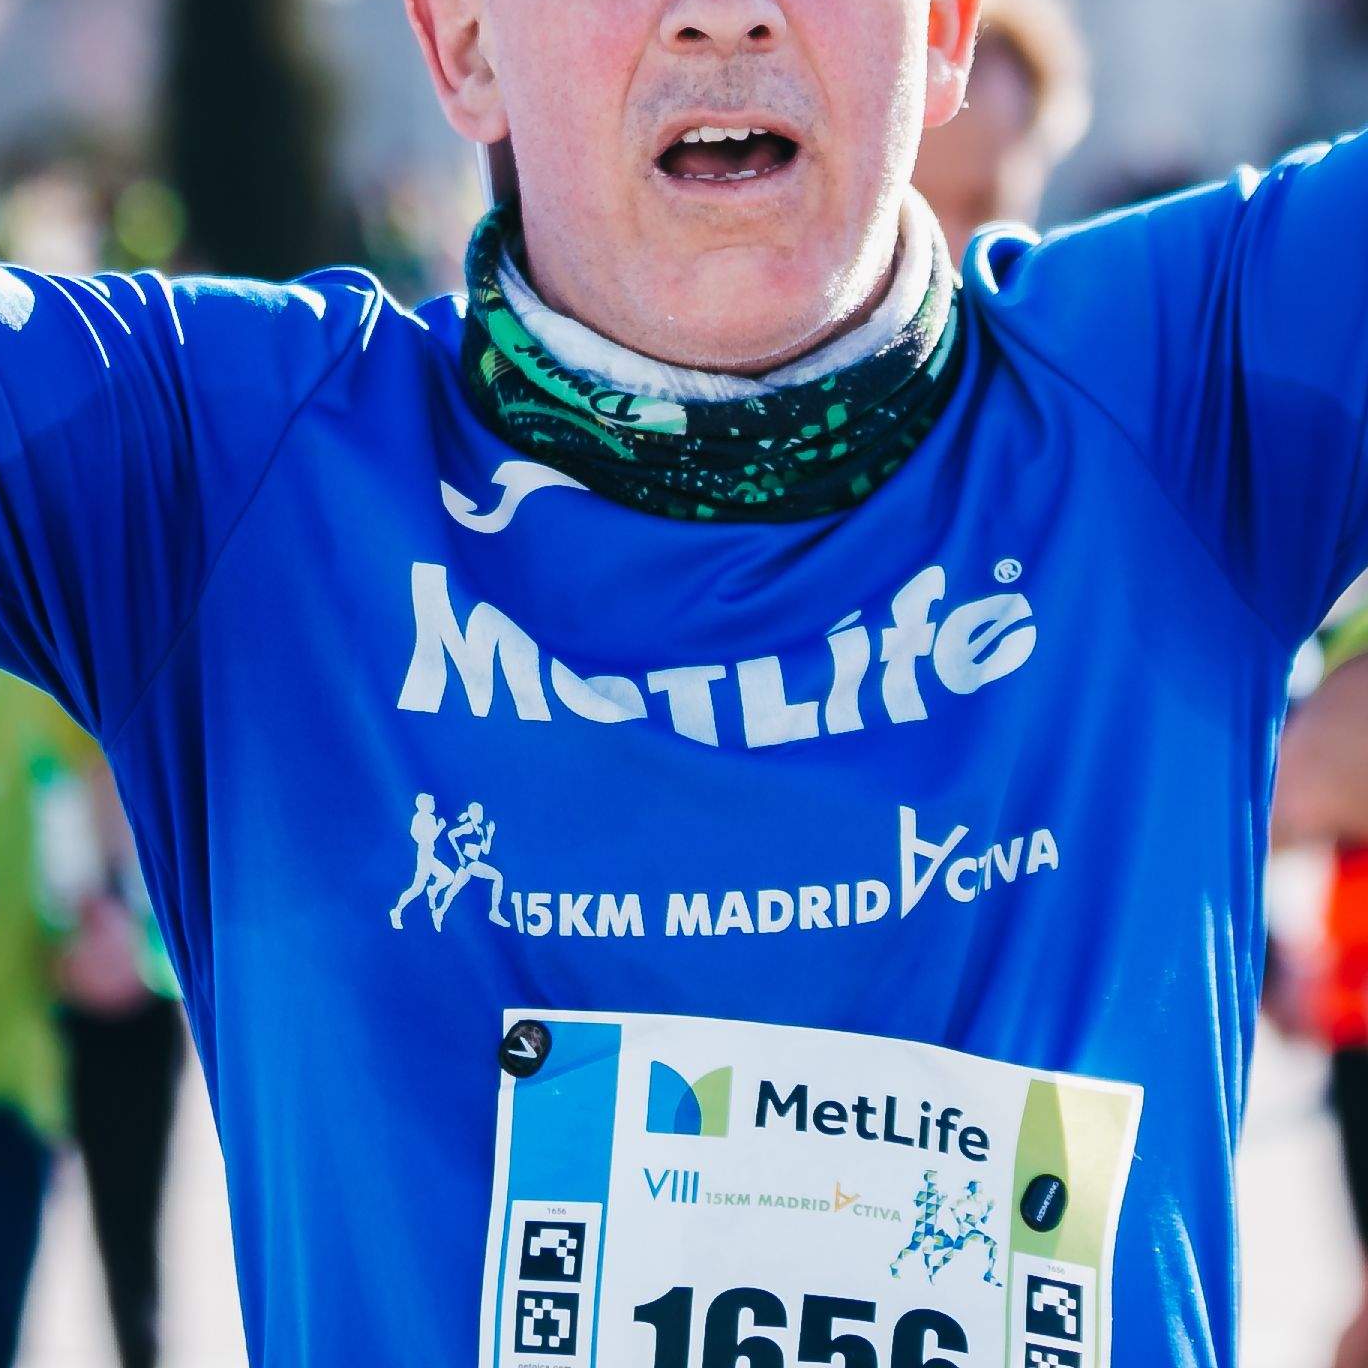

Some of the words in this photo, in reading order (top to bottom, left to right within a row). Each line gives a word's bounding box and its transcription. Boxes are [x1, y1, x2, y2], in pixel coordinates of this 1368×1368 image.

[511, 892, 644, 937] 15KM
[665, 879, 891, 936] MADRID
[755, 1079, 990, 1162] MetLife
[546, 1207, 567, 1216] 1656
[643, 1167, 699, 1204] VIII
[705, 1191, 751, 1206] 15KM
[758, 1193, 831, 1213] MADRID
[633, 1286, 970, 1368] 1656
